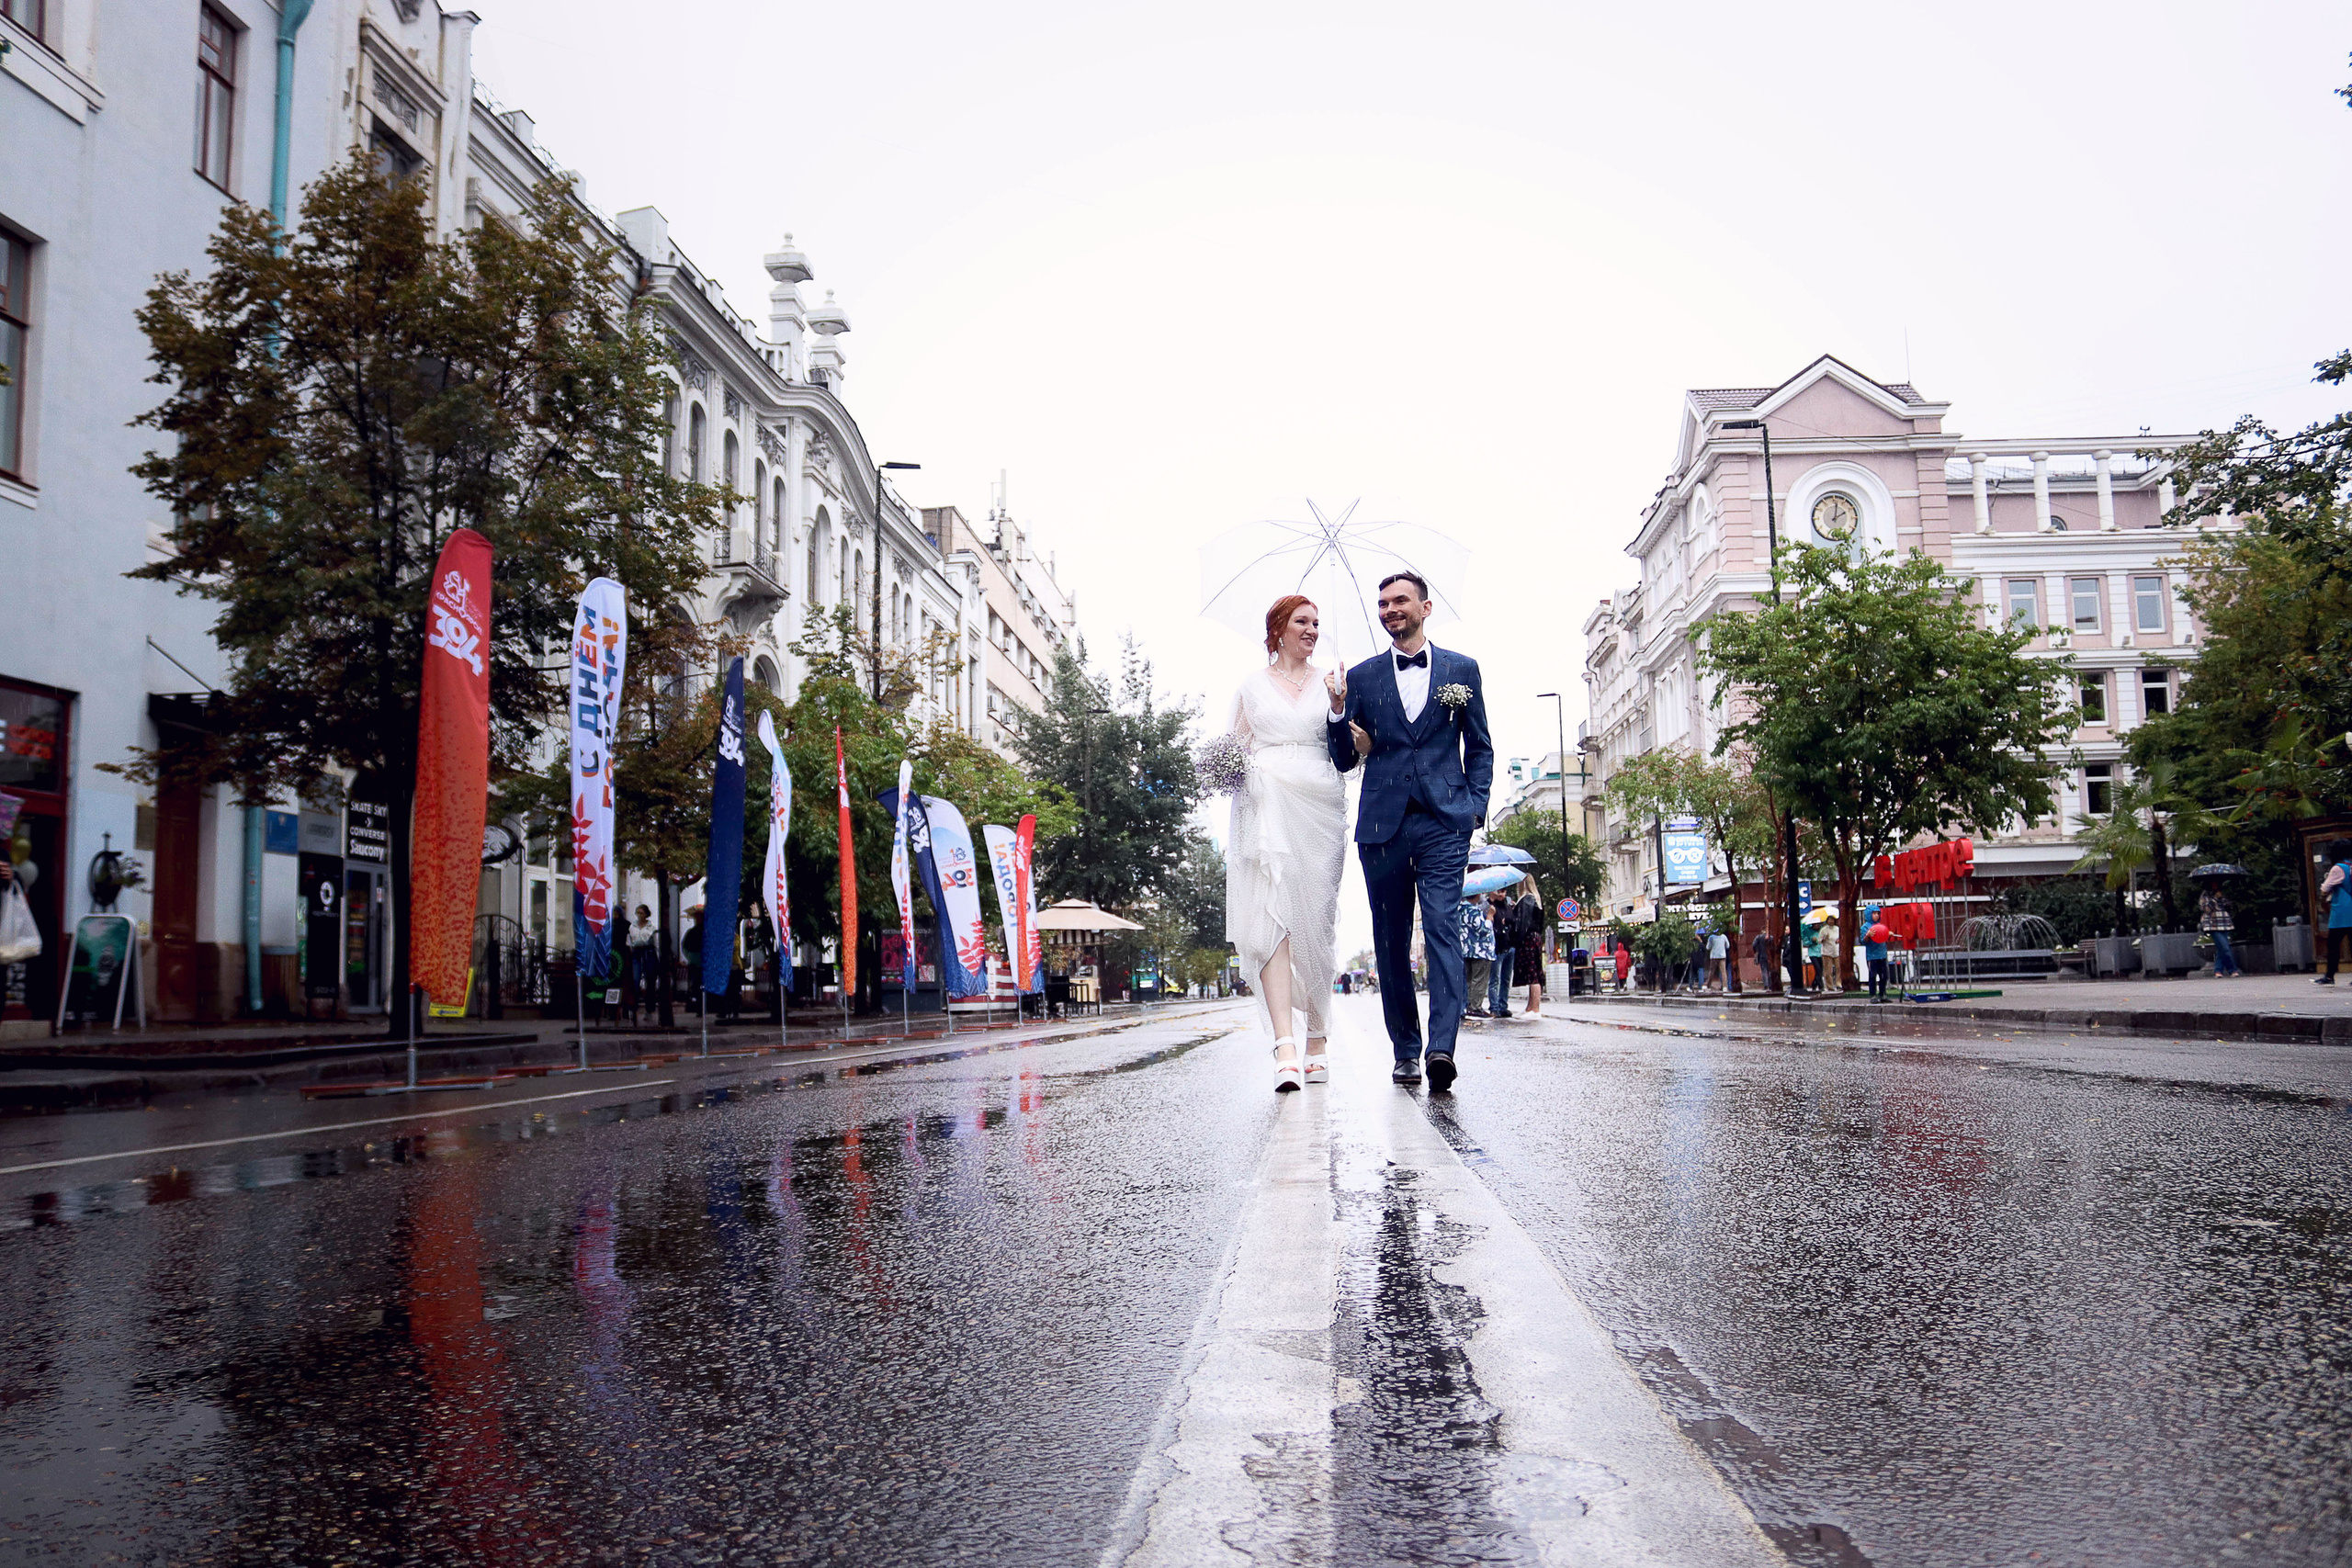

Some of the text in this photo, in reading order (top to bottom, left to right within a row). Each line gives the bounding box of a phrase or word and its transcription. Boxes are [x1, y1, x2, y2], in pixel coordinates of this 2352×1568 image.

[576, 604, 603, 739] ДНЁМ
[350, 801, 388, 817] SKATE SKY
[349, 827, 386, 840] CONVERSE
[350, 839, 384, 862] Saucony
[1894, 838, 1974, 893] центре
